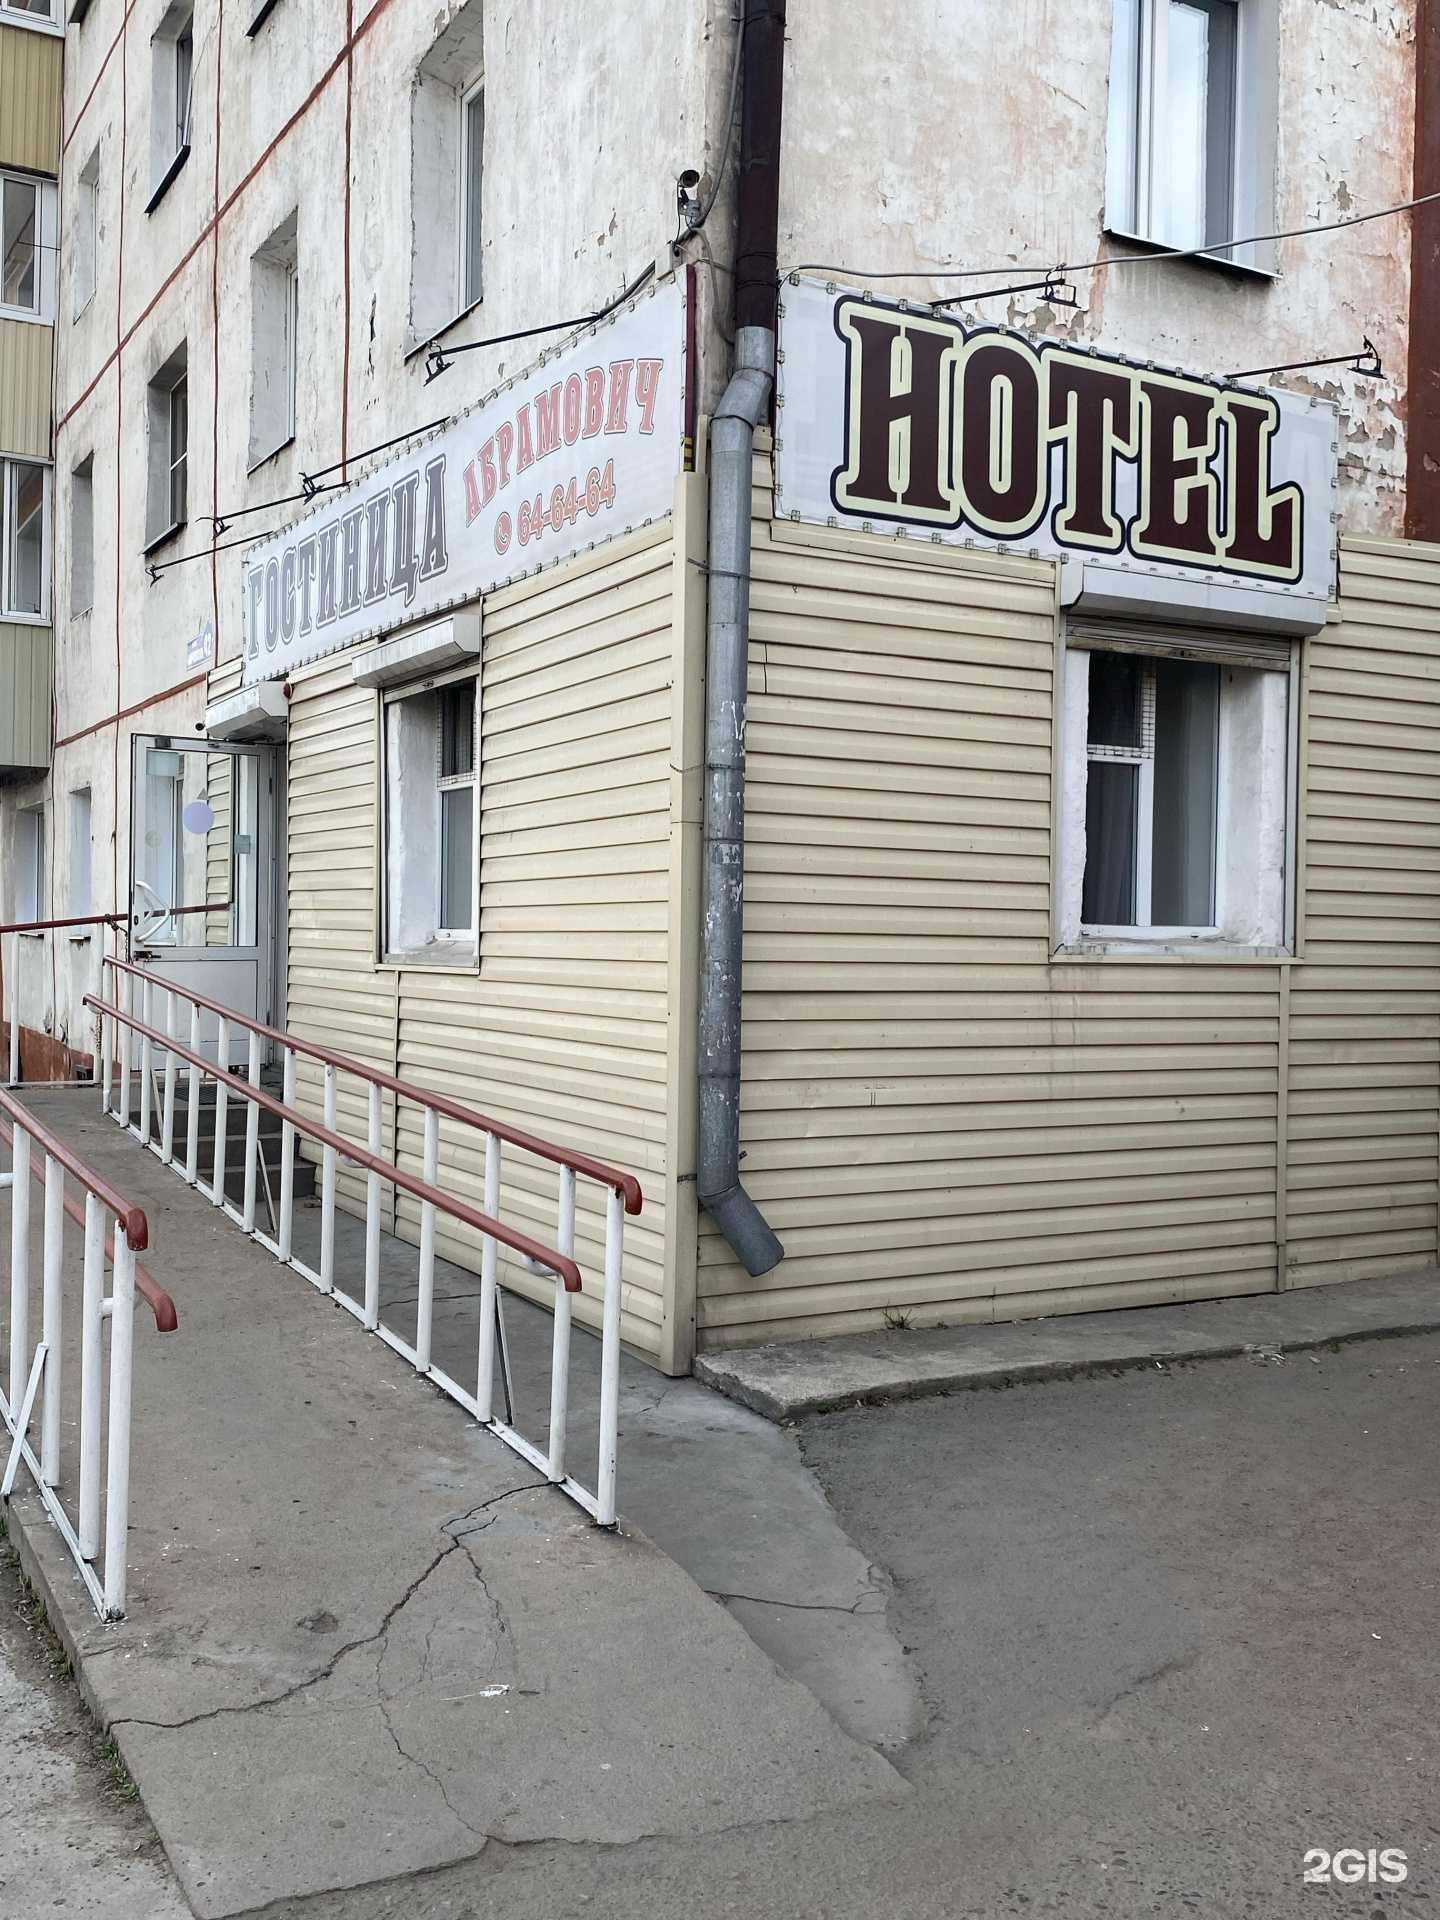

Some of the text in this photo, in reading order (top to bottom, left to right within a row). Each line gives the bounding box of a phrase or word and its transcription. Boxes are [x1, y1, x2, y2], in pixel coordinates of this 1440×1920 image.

[463, 359, 664, 526] АБРАМОВИЧ
[517, 459, 615, 546] 64-64-64
[831, 295, 1304, 583] HOTEL
[248, 454, 448, 660] ГОСТИНИЦА
